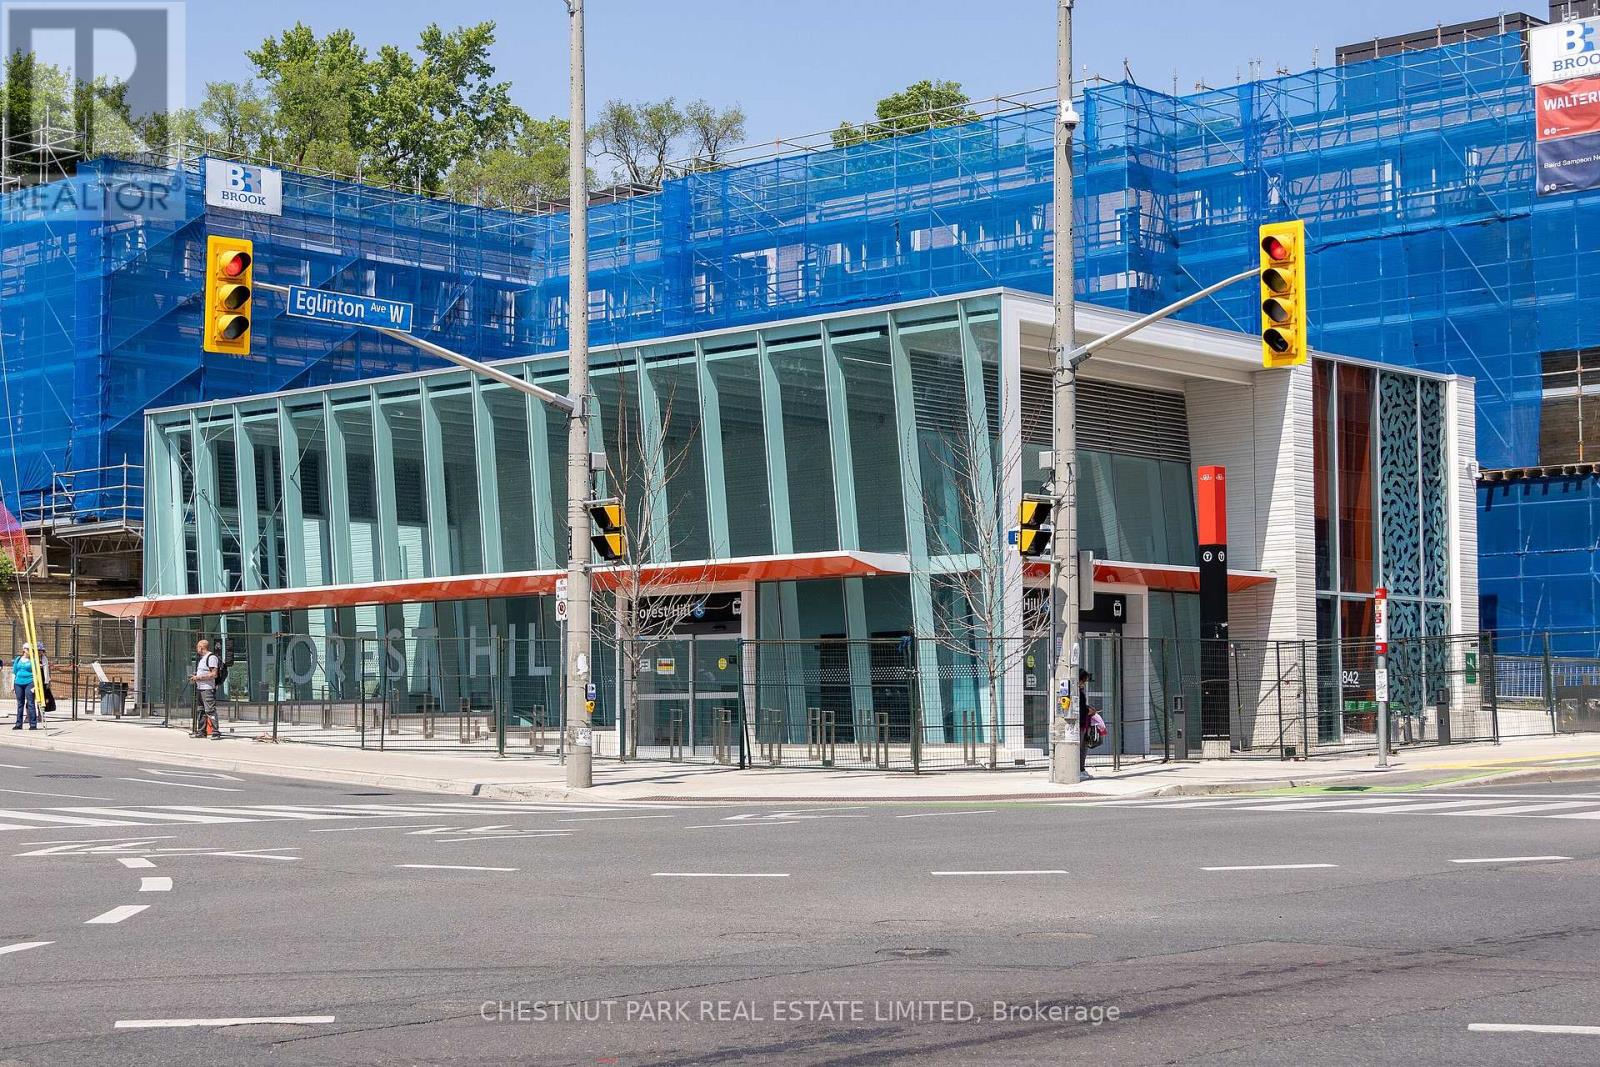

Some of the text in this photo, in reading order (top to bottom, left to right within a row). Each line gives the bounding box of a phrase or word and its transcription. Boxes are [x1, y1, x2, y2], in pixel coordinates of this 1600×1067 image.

[221, 190, 267, 206] BROOK
[296, 290, 405, 324] Eglinton Ave W
[636, 604, 668, 619] orest
[261, 626, 439, 685] FOREST
[1342, 670, 1359, 684] 842
